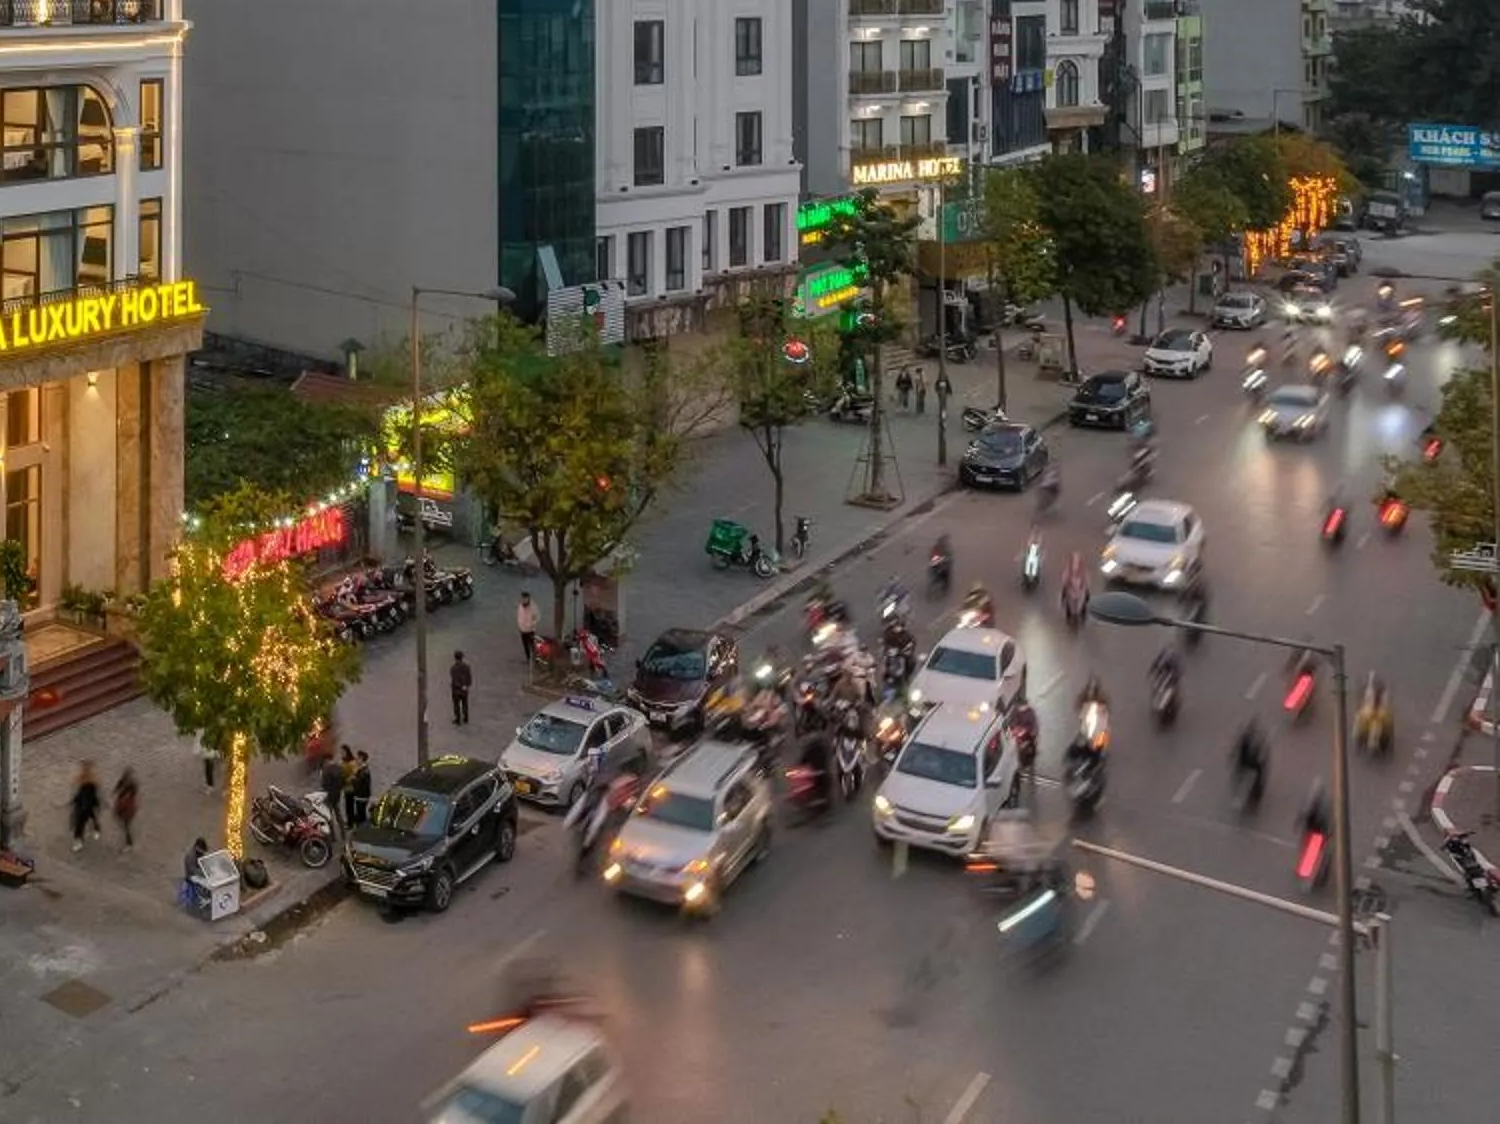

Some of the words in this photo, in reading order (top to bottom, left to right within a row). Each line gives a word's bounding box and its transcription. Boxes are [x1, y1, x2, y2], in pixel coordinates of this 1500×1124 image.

[1412, 127, 1476, 145] KHÁCH
[853, 161, 913, 185] MARINA
[12, 295, 116, 348] LUXURY
[121, 281, 202, 326] HOTEL
